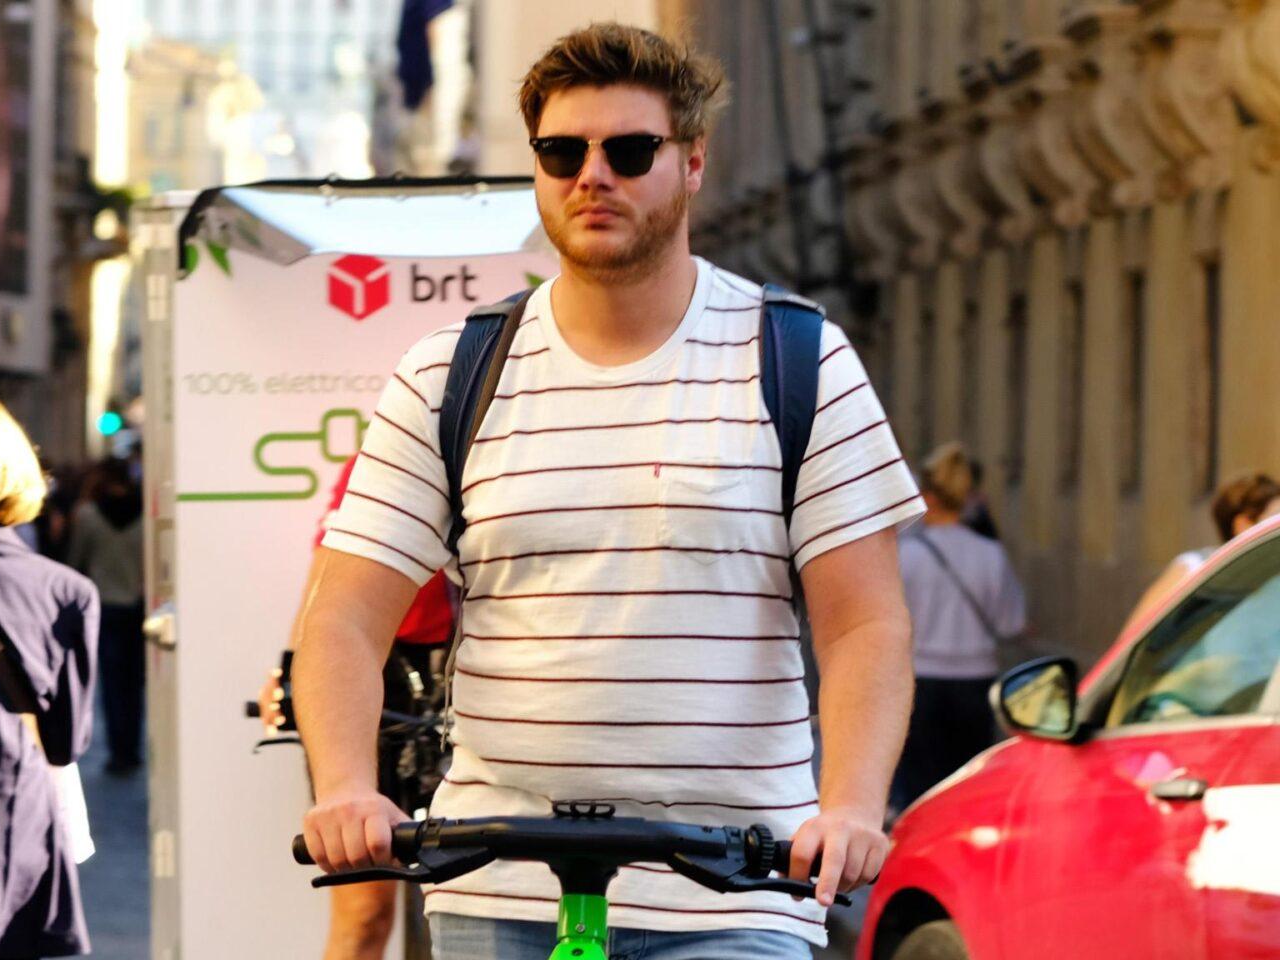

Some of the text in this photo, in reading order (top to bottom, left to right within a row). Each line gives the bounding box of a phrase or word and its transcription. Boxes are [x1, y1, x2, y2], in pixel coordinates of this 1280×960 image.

[410, 264, 477, 302] brt
[184, 371, 386, 395] 100% elettrico
